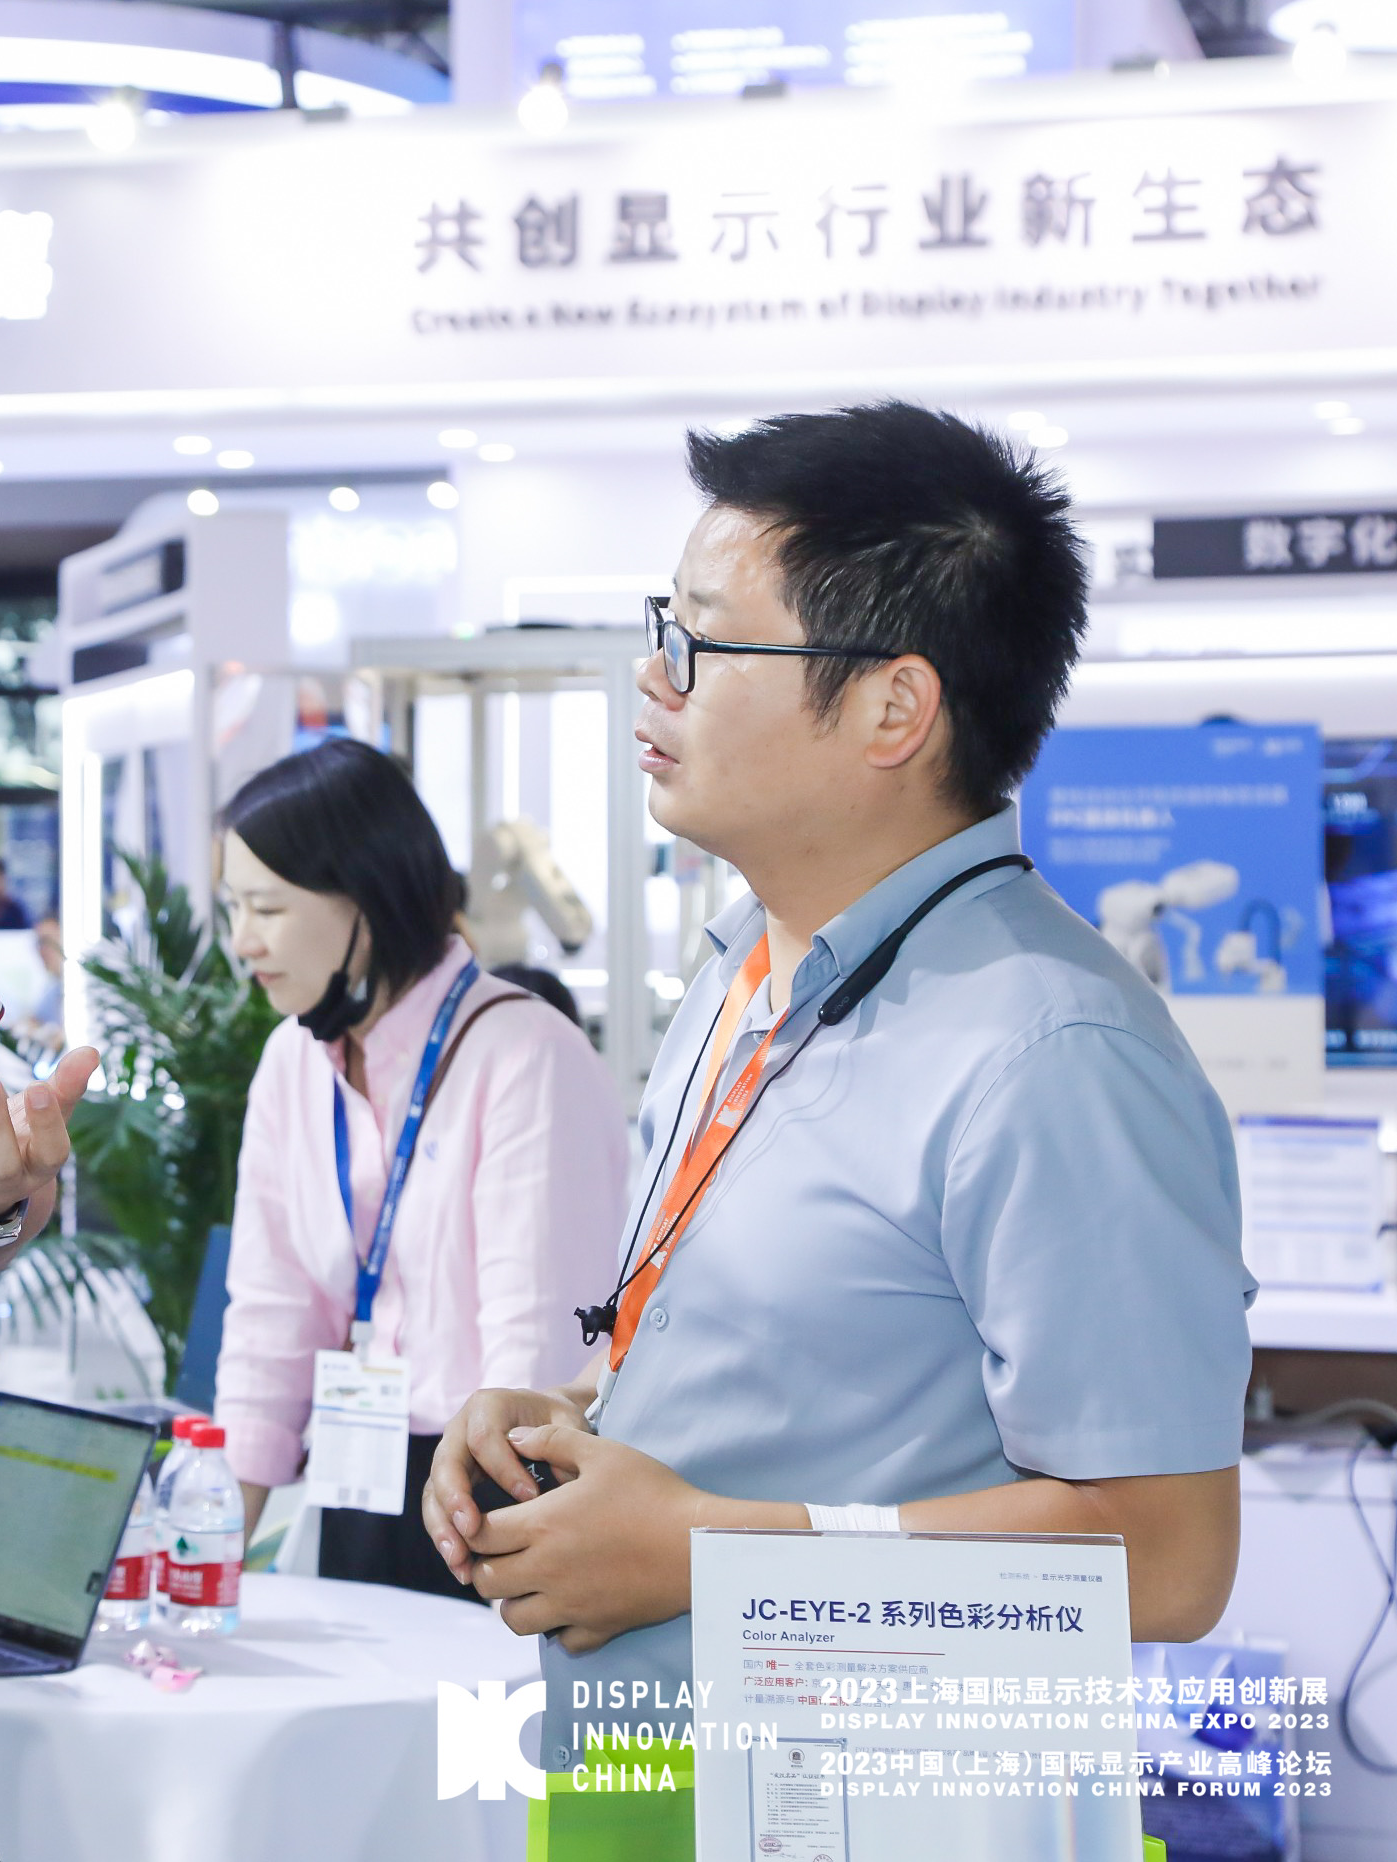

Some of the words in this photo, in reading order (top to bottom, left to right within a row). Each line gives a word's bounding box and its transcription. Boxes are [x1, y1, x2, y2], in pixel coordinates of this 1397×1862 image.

[412, 155, 1324, 275] 共创显示行业新生态
[411, 305, 512, 336] Create
[551, 301, 614, 327] New
[818, 291, 850, 318] of
[861, 289, 983, 321] Display
[992, 281, 1147, 318] Industry
[1162, 272, 1321, 309] Together
[1243, 516, 1397, 570] 数字化
[656, 1217, 670, 1241] DISPLAY
[1041, 1573, 1103, 1582] 显示光学测量仪器
[743, 1598, 872, 1624] JC-EYE-2
[880, 1600, 1084, 1633] 系列色彩分析仪
[743, 1629, 778, 1643] Color
[780, 1631, 836, 1645] Analyzer
[743, 1659, 764, 1670] 国内
[766, 1659, 790, 1671] 唯一
[794, 1661, 929, 1676] 全套色彩测量解决方案供应商
[744, 1693, 795, 1705] 计量溯源与
